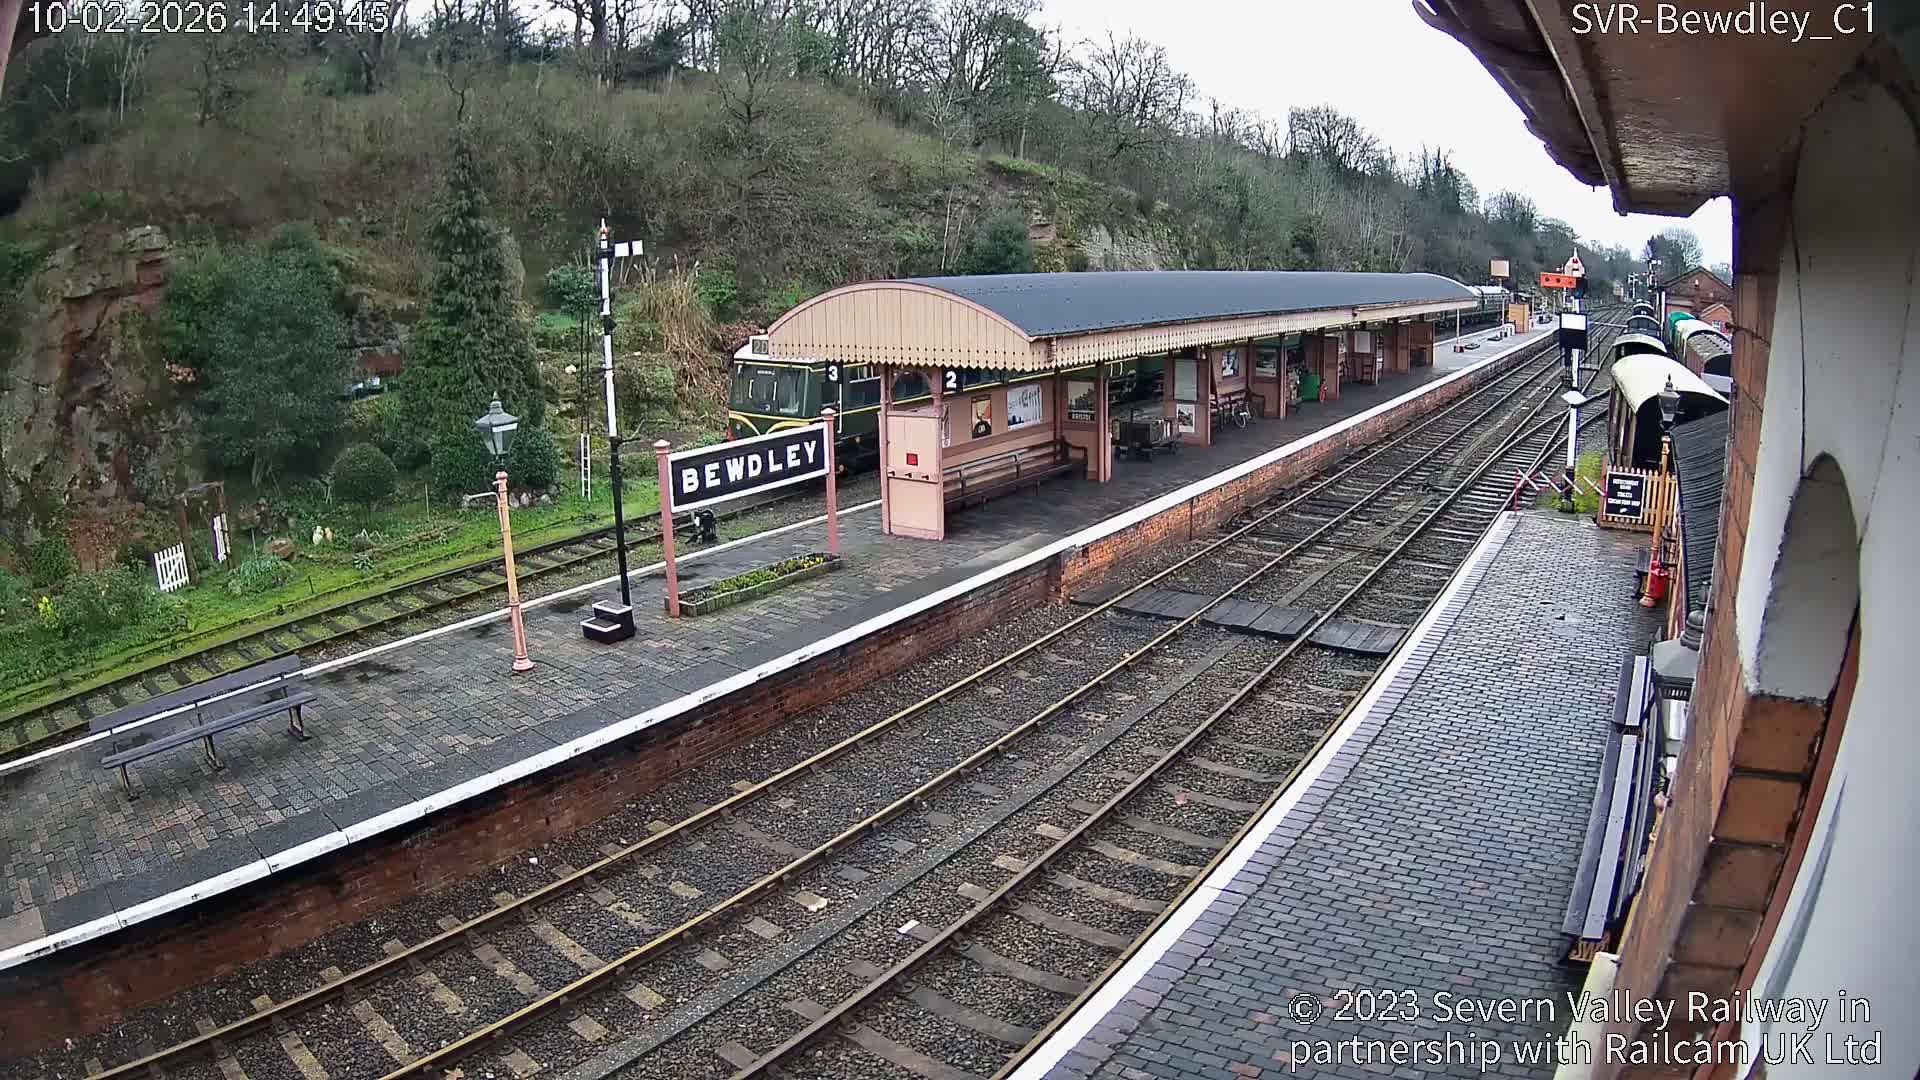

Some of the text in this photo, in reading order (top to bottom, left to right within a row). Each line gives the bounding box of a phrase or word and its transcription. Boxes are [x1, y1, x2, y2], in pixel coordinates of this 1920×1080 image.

[828, 365, 839, 381] 3
[945, 370, 957, 389] 2
[681, 440, 817, 494] BEWDLEY
